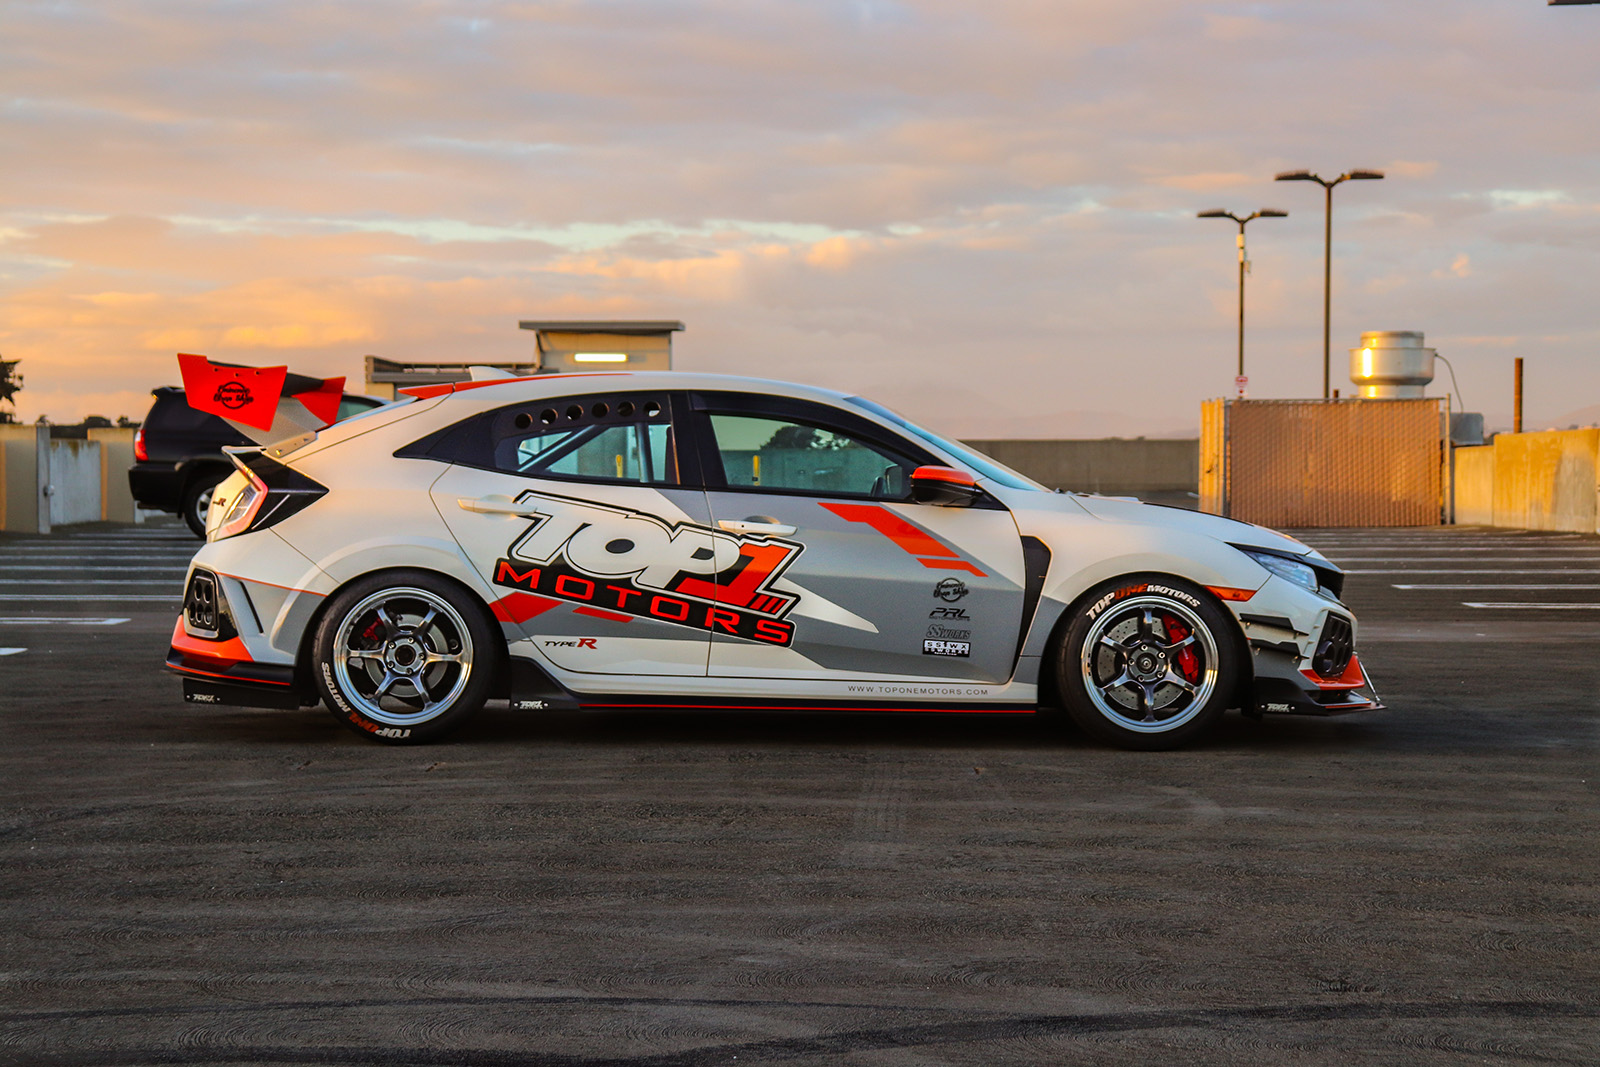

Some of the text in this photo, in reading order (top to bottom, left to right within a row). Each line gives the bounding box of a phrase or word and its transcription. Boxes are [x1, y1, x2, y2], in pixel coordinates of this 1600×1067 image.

[496, 560, 792, 643] MOTORS
[930, 607, 970, 618] PRL
[577, 637, 598, 649] R
[847, 685, 989, 696] WWW.TOPONEMOTORS.COM
